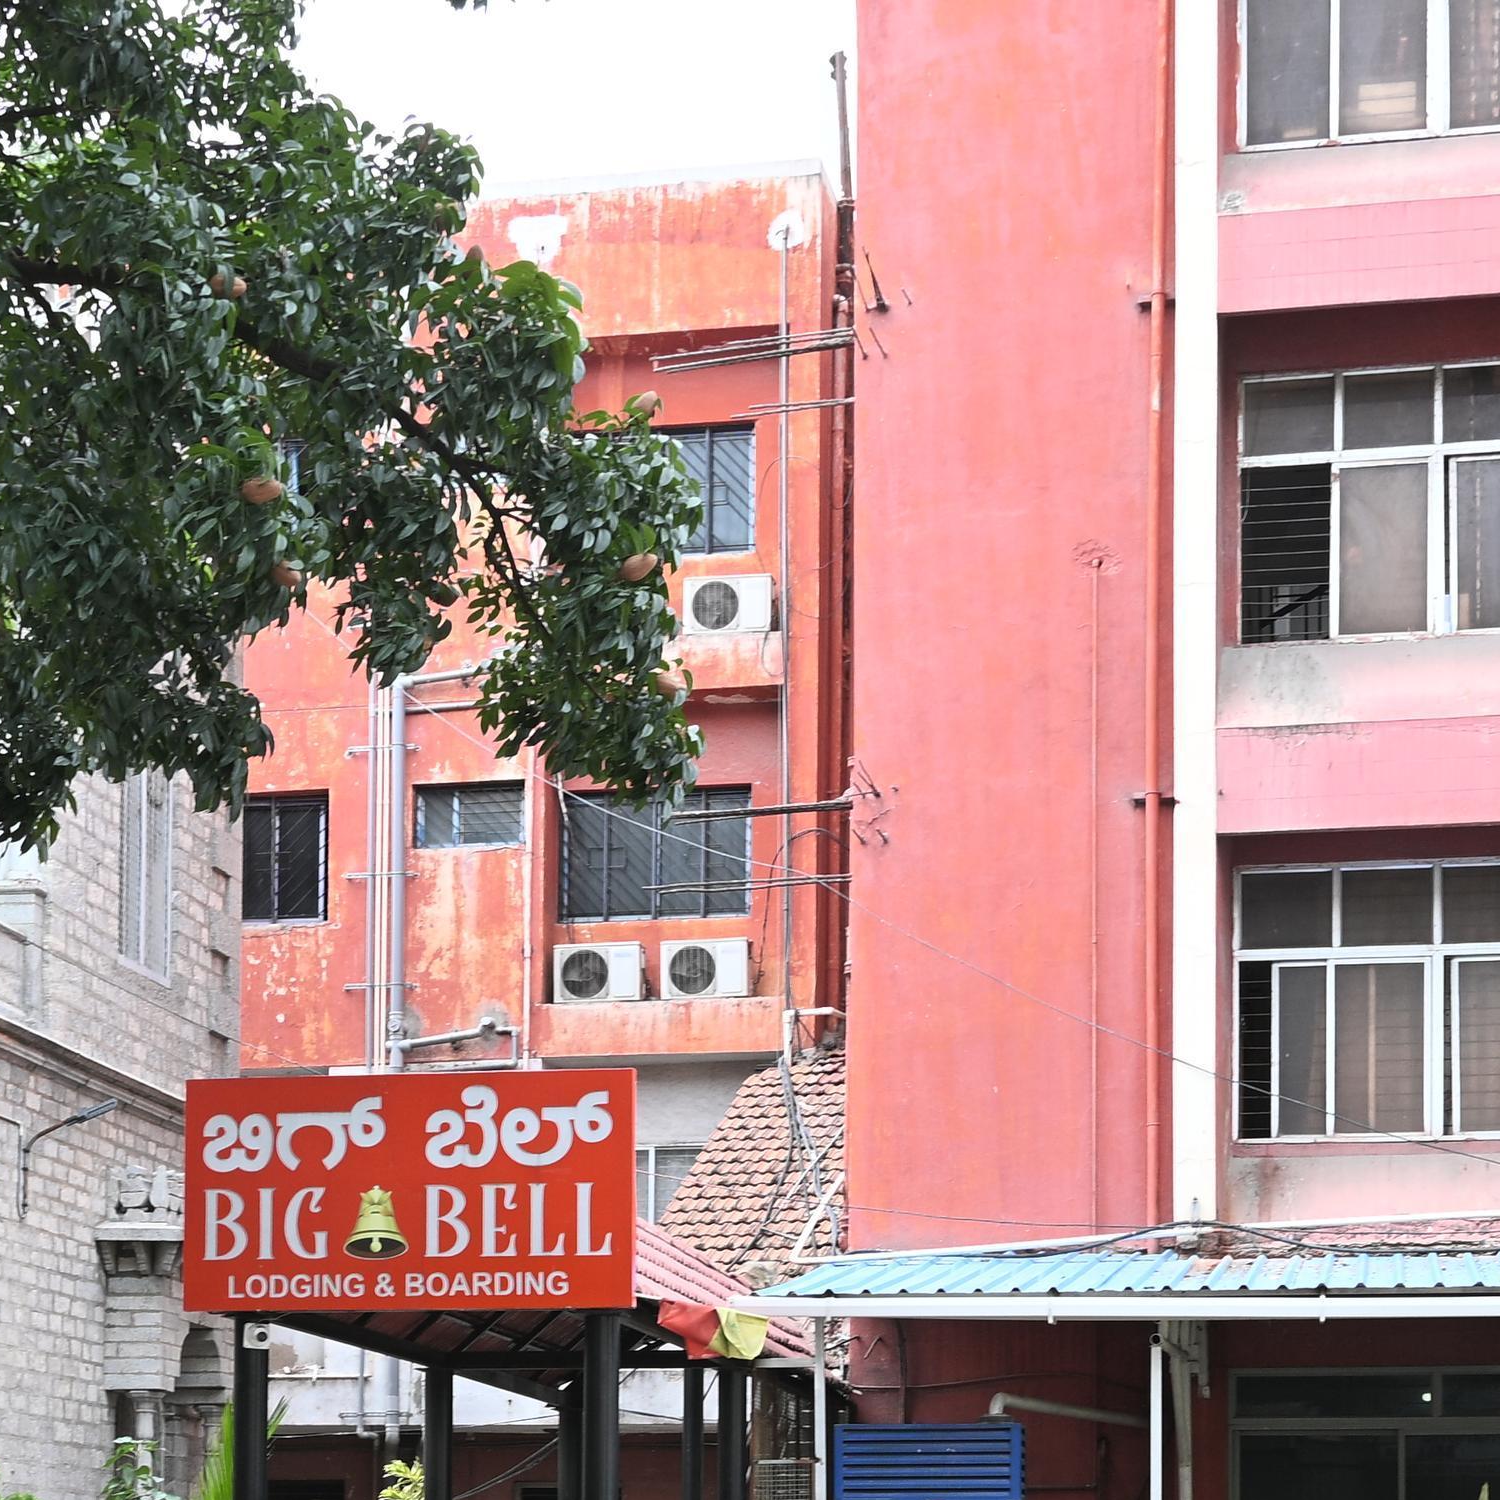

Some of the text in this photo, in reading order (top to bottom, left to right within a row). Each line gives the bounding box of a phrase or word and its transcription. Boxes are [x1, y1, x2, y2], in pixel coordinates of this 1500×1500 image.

[203, 1085, 613, 1172] ಬಿಗ್ ಬೆಲ್
[203, 1182, 613, 1261] BIG BELL
[228, 1271, 570, 1299] LODGING & BOARDING
